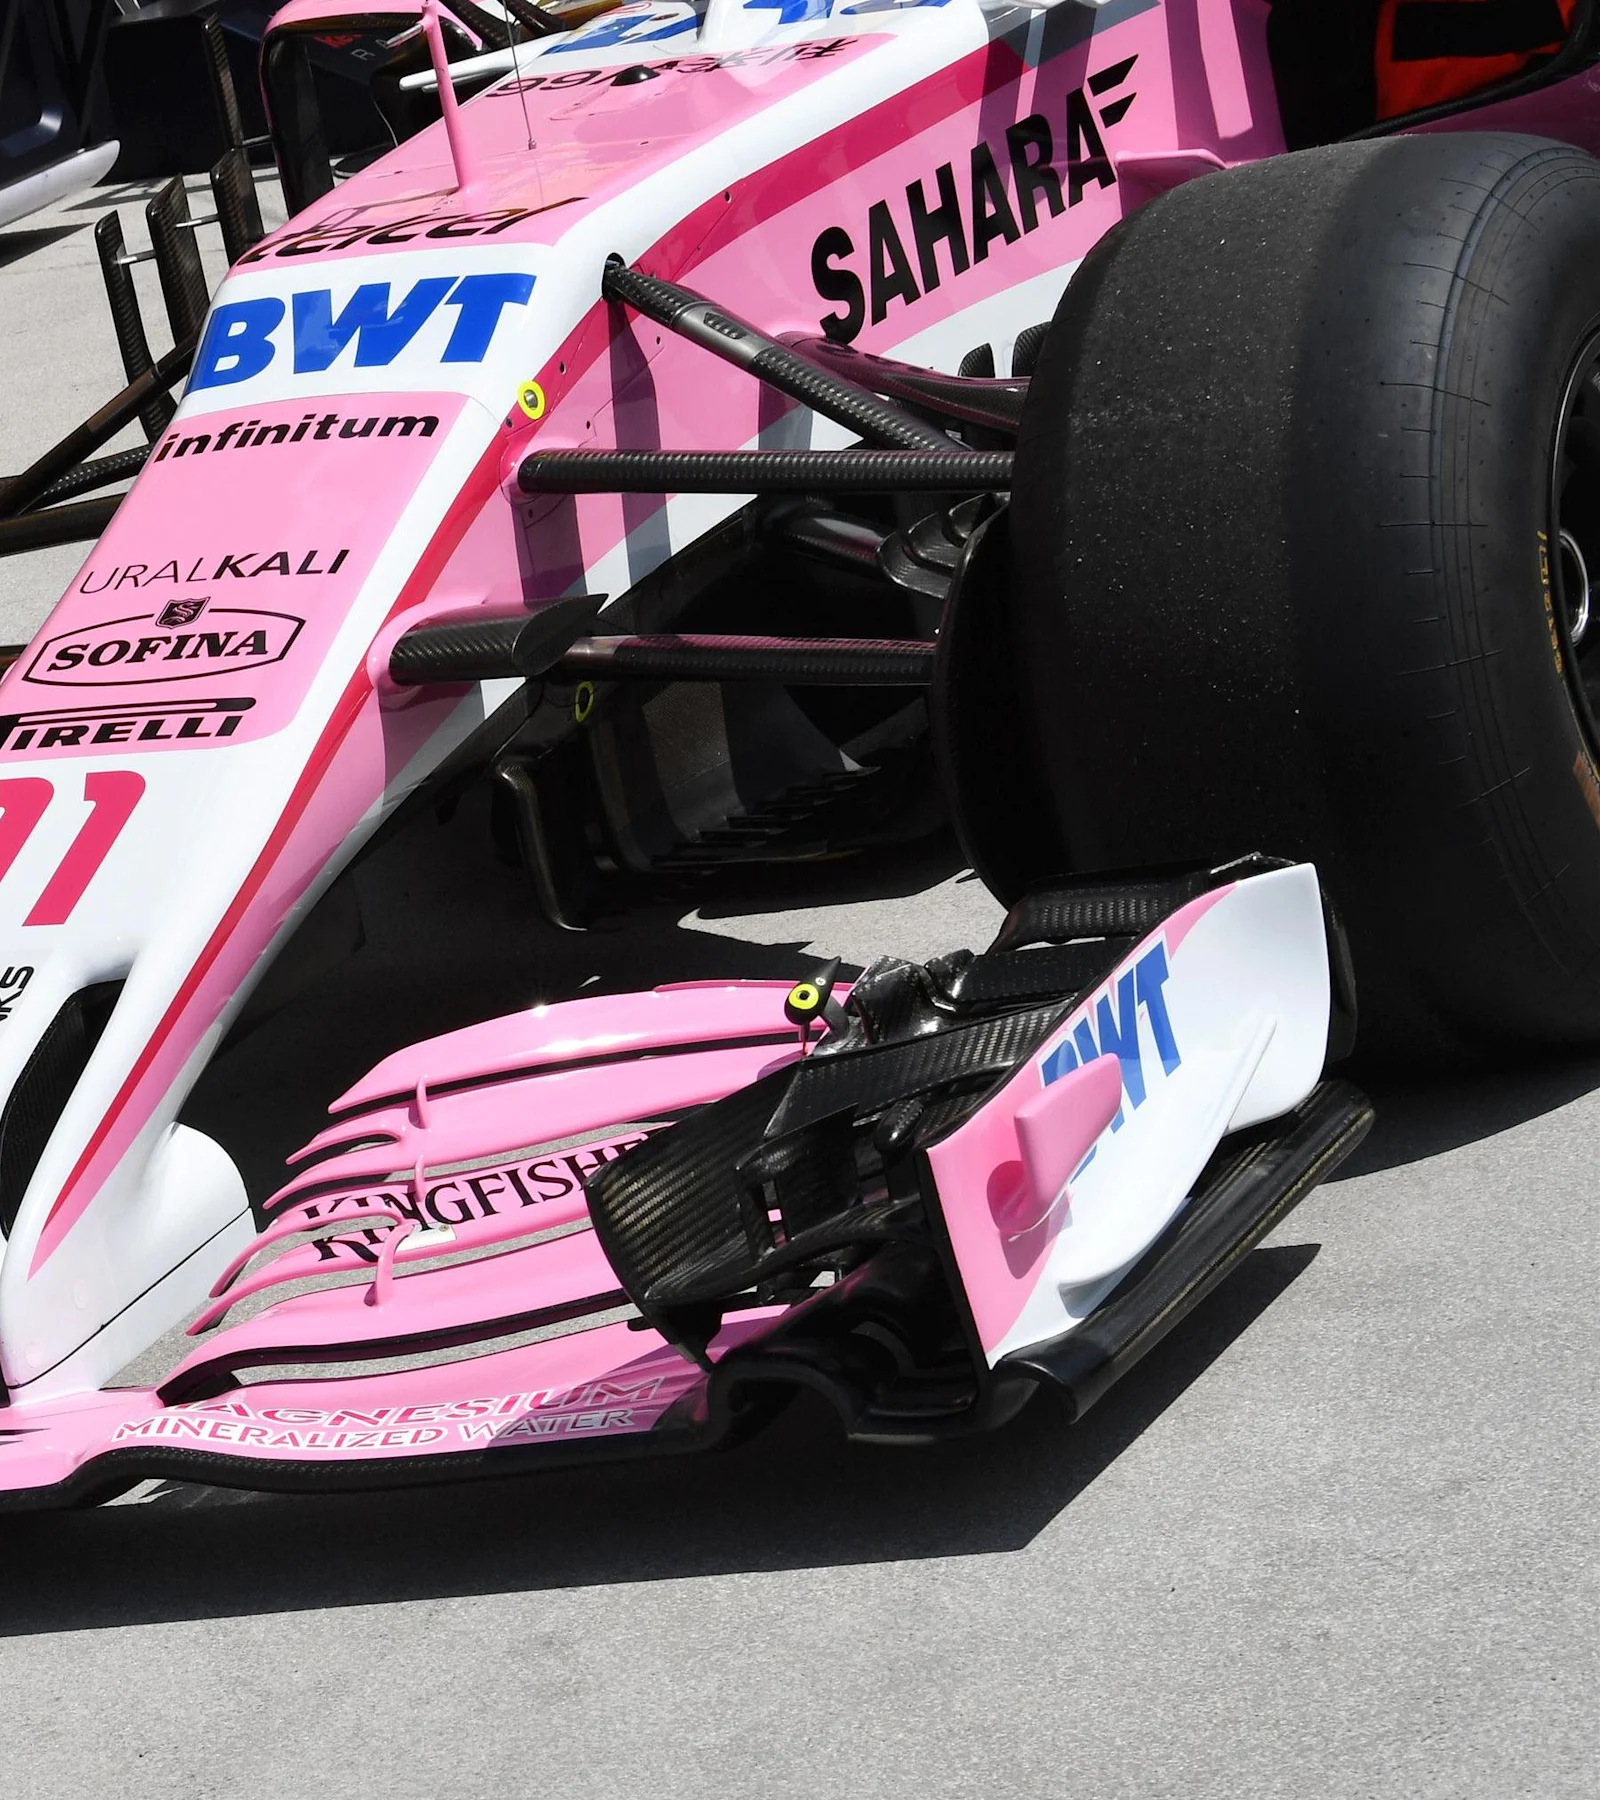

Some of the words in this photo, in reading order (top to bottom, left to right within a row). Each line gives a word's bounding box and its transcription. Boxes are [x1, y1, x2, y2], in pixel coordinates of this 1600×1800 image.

[810, 86, 1118, 346] SAHARA
[184, 272, 537, 395] BWT
[155, 412, 440, 463] infinitum
[79, 549, 350, 594] URALKALI
[46, 630, 269, 672] SOFINA
[164, 1376, 667, 1427] AGNESIUM
[111, 1415, 447, 1450] MINERALIZED
[458, 1408, 636, 1442] WATER
